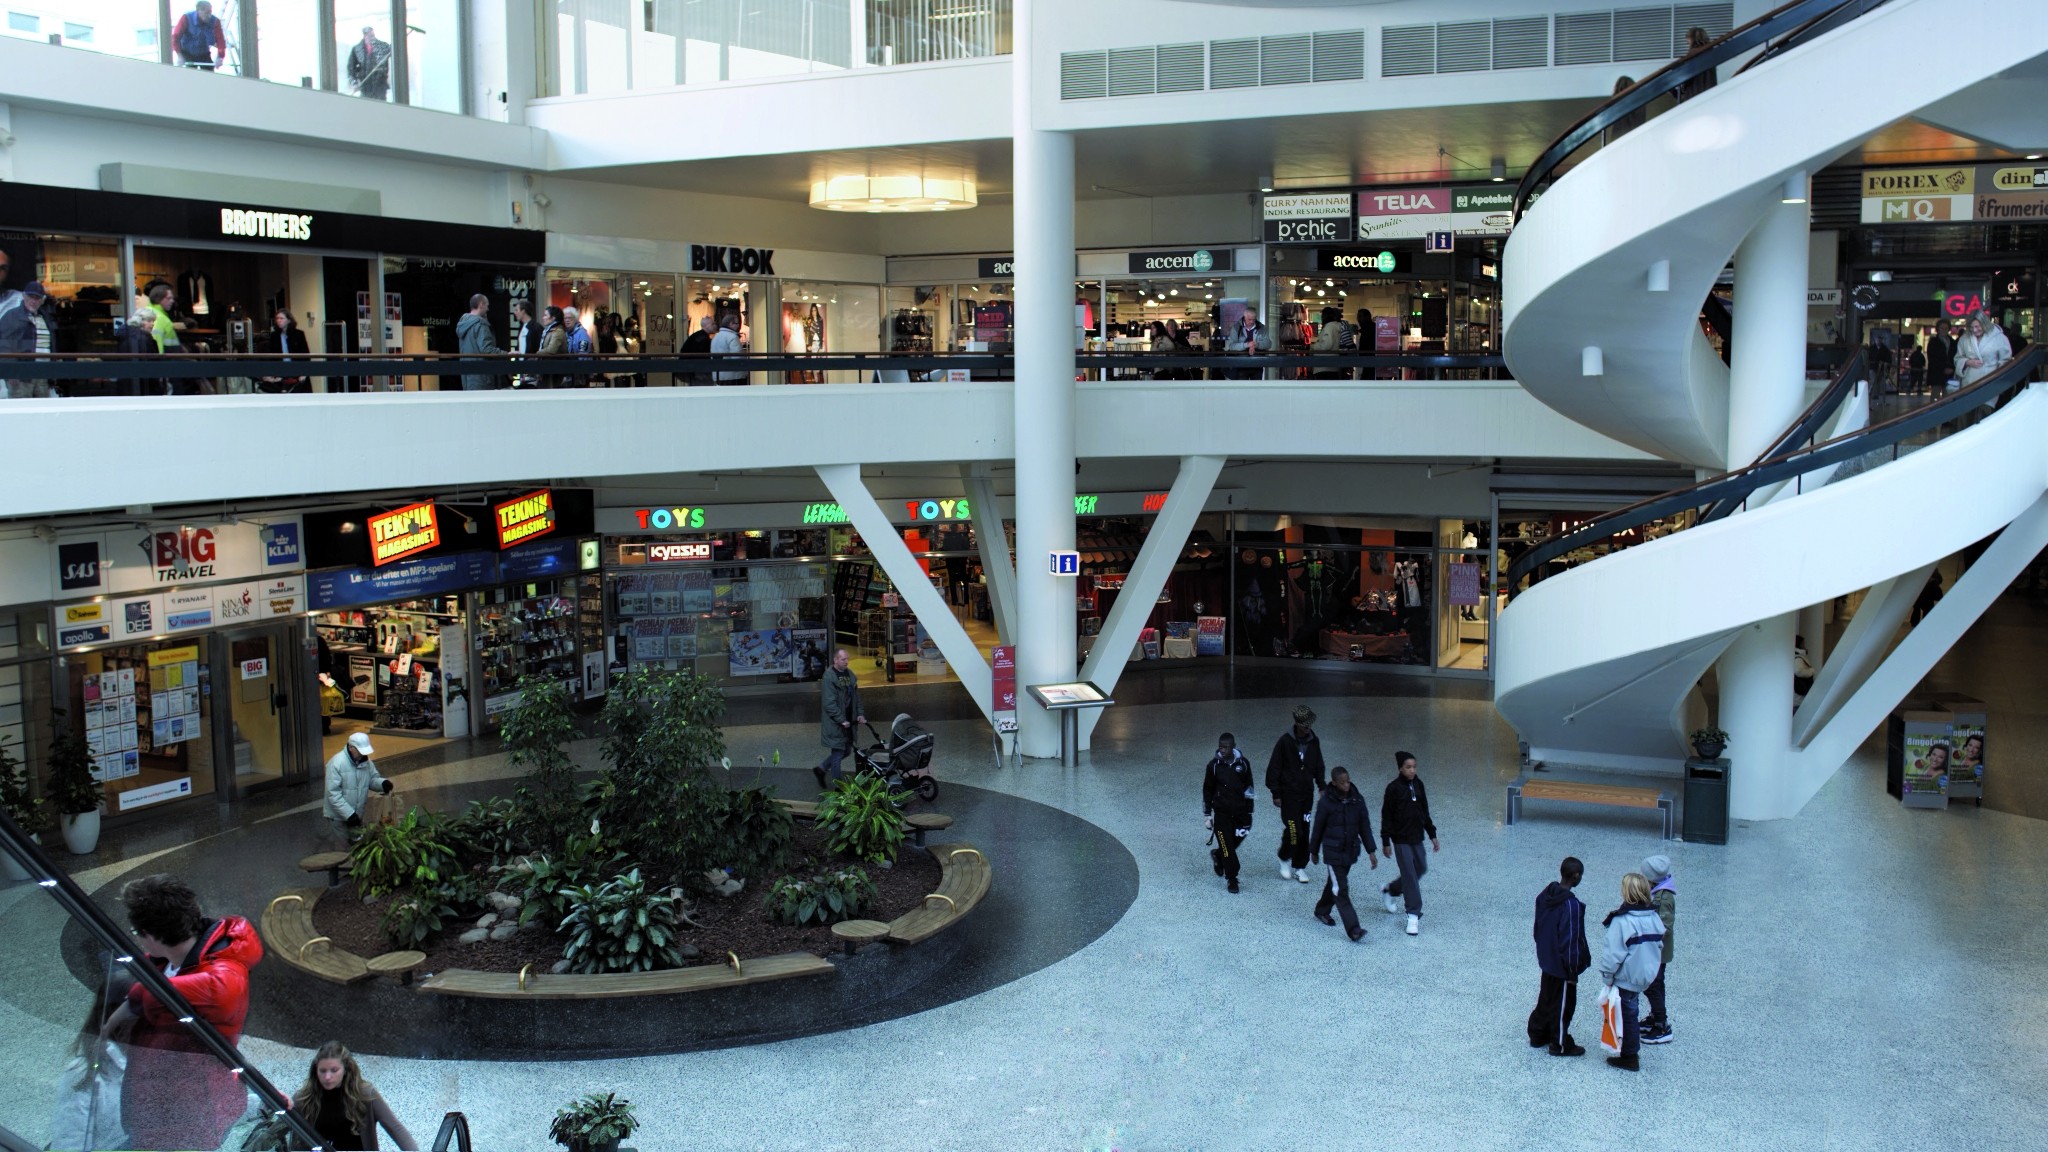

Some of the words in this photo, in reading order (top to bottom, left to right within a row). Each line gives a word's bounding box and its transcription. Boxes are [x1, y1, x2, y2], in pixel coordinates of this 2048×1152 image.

[1869, 174, 1939, 190] FOREX
[2001, 172, 2032, 184] din
[1264, 199, 1298, 208] CURRY
[1300, 197, 1324, 207] NAM
[1326, 197, 1349, 206] NAM
[1373, 194, 1436, 211] TELIA
[1471, 194, 1512, 207] Apoteket
[1264, 208, 1293, 216] INDISK
[1296, 207, 1350, 215] RESTAURANG
[1886, 200, 1934, 221] MQ
[221, 208, 311, 240] BROTHERS
[691, 244, 726, 273] BIK
[730, 248, 774, 275] BOK
[993, 260, 1014, 274] acc
[1146, 253, 1200, 269] accent
[1333, 254, 1384, 268] accent
[1827, 293, 1837, 301] IF
[1945, 294, 1988, 316] GA
[498, 492, 549, 528] TEKNIK
[635, 507, 705, 529] TOYS
[803, 503, 849, 523] LEKSA
[906, 499, 970, 520] TOYS
[372, 504, 432, 543] TEKNIK
[502, 517, 551, 544] MAGASINE
[155, 527, 216, 567] BIG
[268, 544, 298, 558] KLM
[377, 528, 436, 560] MAGASINET
[650, 544, 710, 561] KYOSHO
[63, 561, 97, 580] SAS
[157, 564, 216, 582] TRAVEL
[65, 630, 94, 644] apollo
[247, 660, 263, 672] BIG
